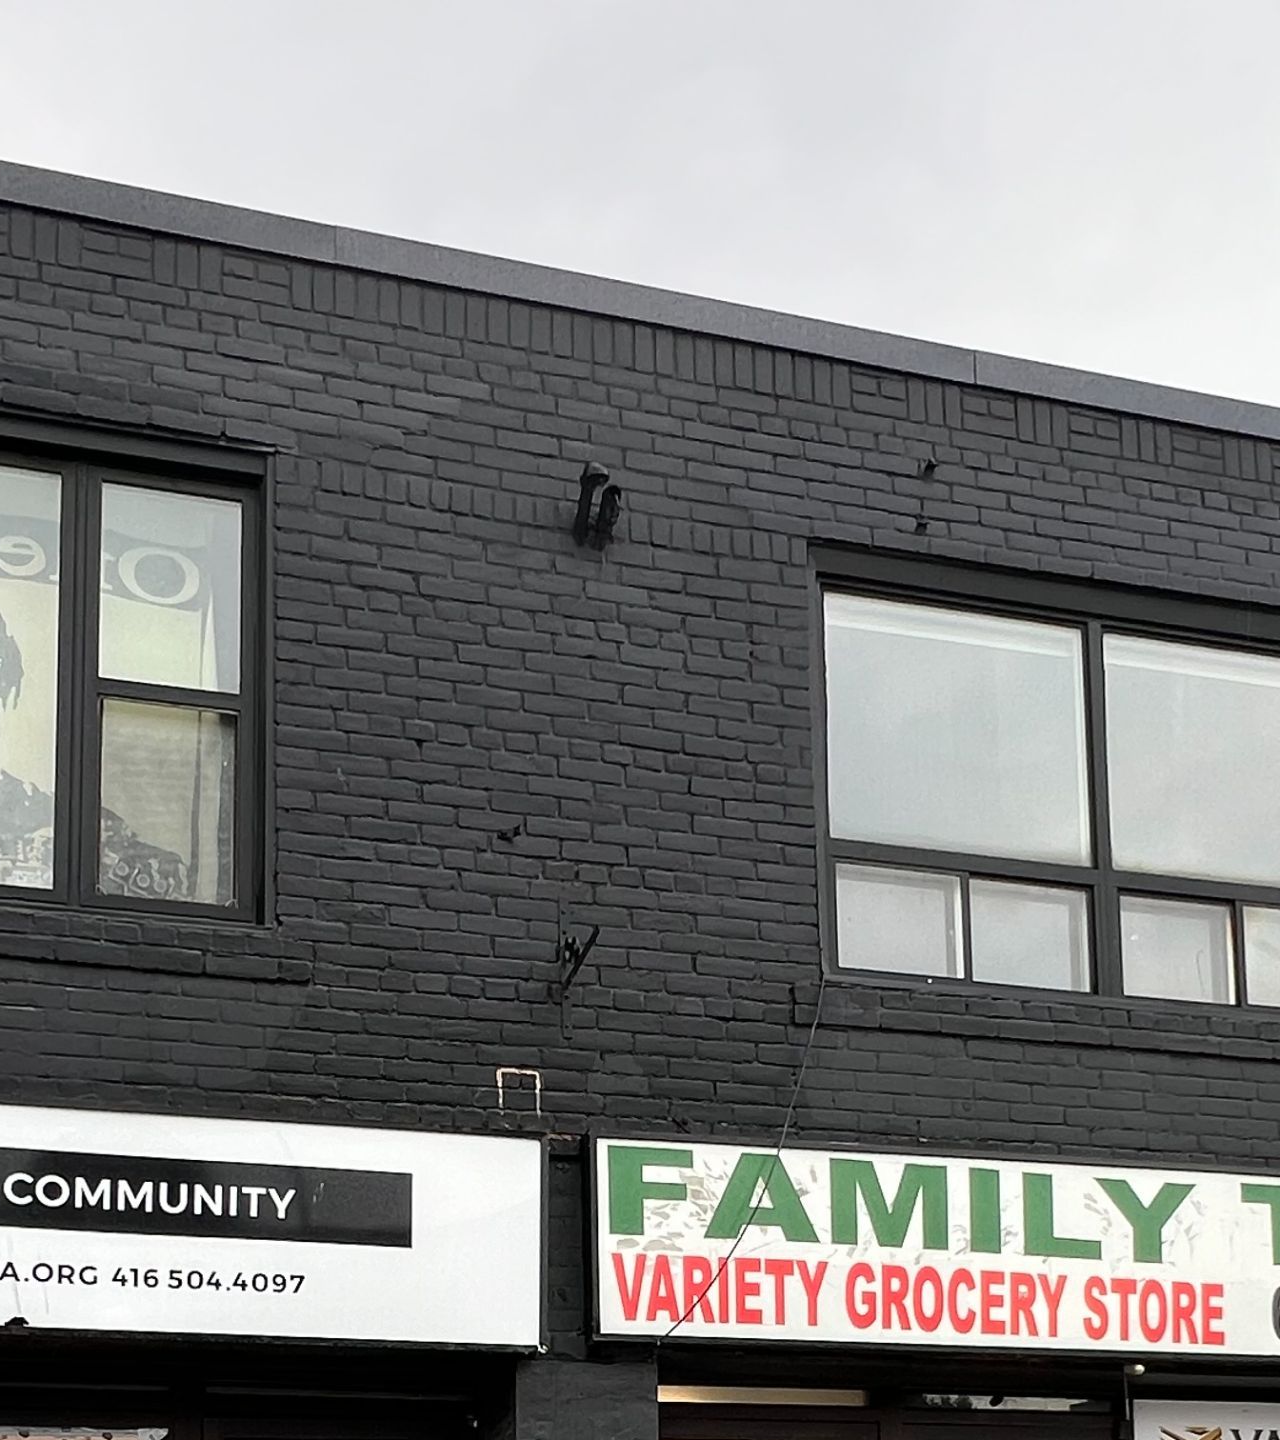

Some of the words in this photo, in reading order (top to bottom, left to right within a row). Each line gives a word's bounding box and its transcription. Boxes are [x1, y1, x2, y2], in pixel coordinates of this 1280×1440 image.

[2, 1172, 297, 1220] COMMUNITY
[607, 1145, 1196, 1266] FAMILY
[111, 1267, 160, 1289] 416
[167, 1268, 307, 1295] 504.4097
[611, 1253, 831, 1328] VARIETY
[844, 1260, 1068, 1338] GROCERY
[1081, 1274, 1225, 1346] STORE
